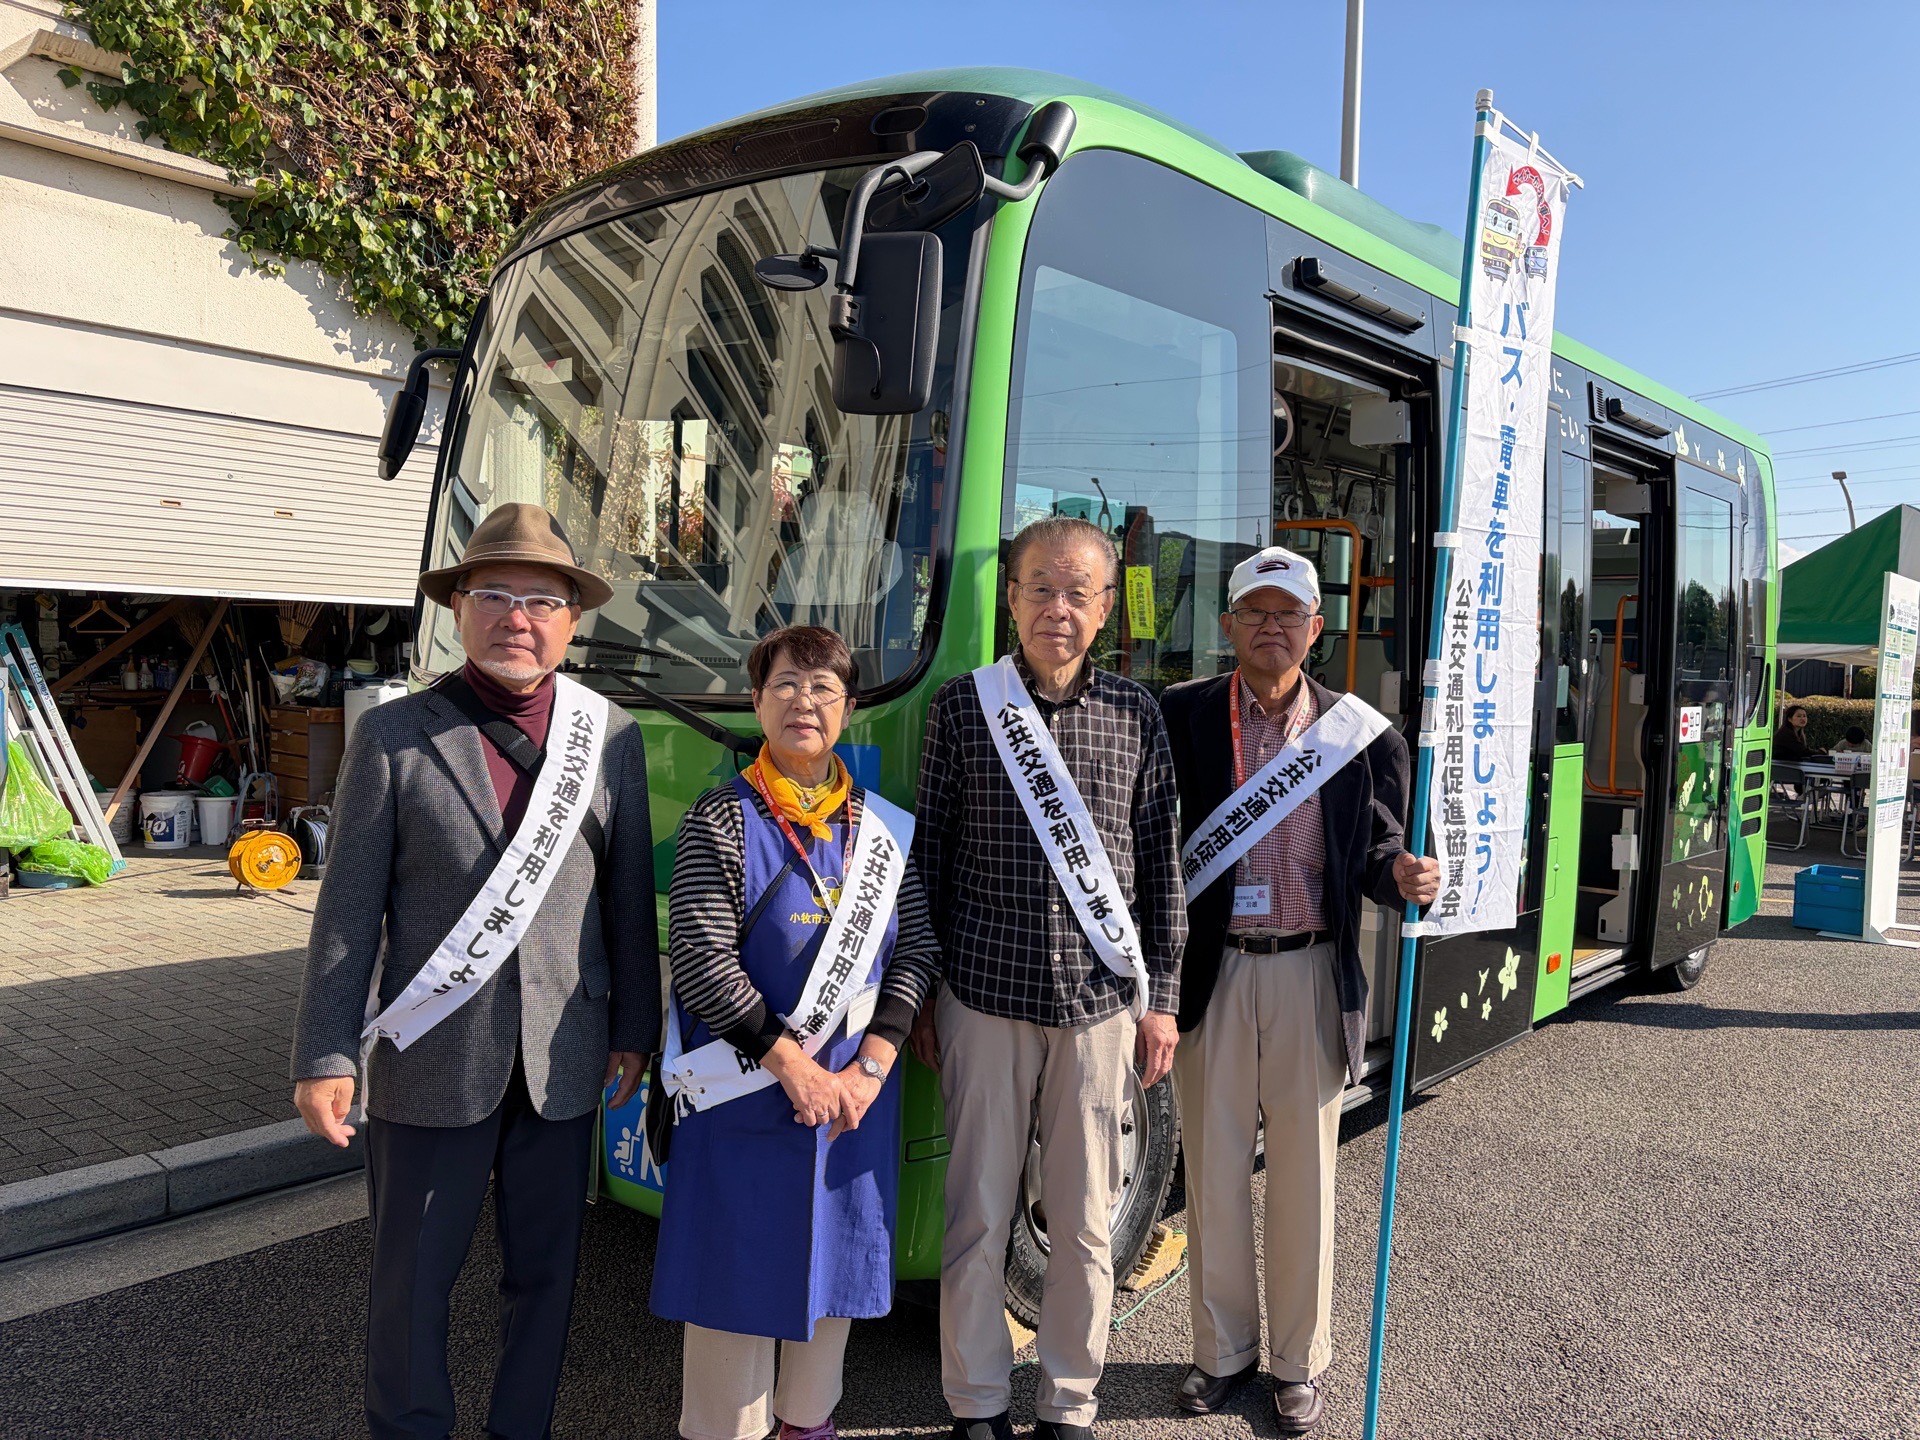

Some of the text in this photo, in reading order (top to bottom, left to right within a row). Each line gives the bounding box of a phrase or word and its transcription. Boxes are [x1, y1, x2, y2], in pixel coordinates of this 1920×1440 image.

[1471, 302, 1531, 915] バス・電車を利用しましょう!
[997, 702, 1137, 968] 公共交通を利用しましょ
[1182, 748, 1324, 885] 公共交通利用促進
[1440, 578, 1473, 918] 公共交通利用促進協議会
[790, 912, 832, 925] 小牧市女
